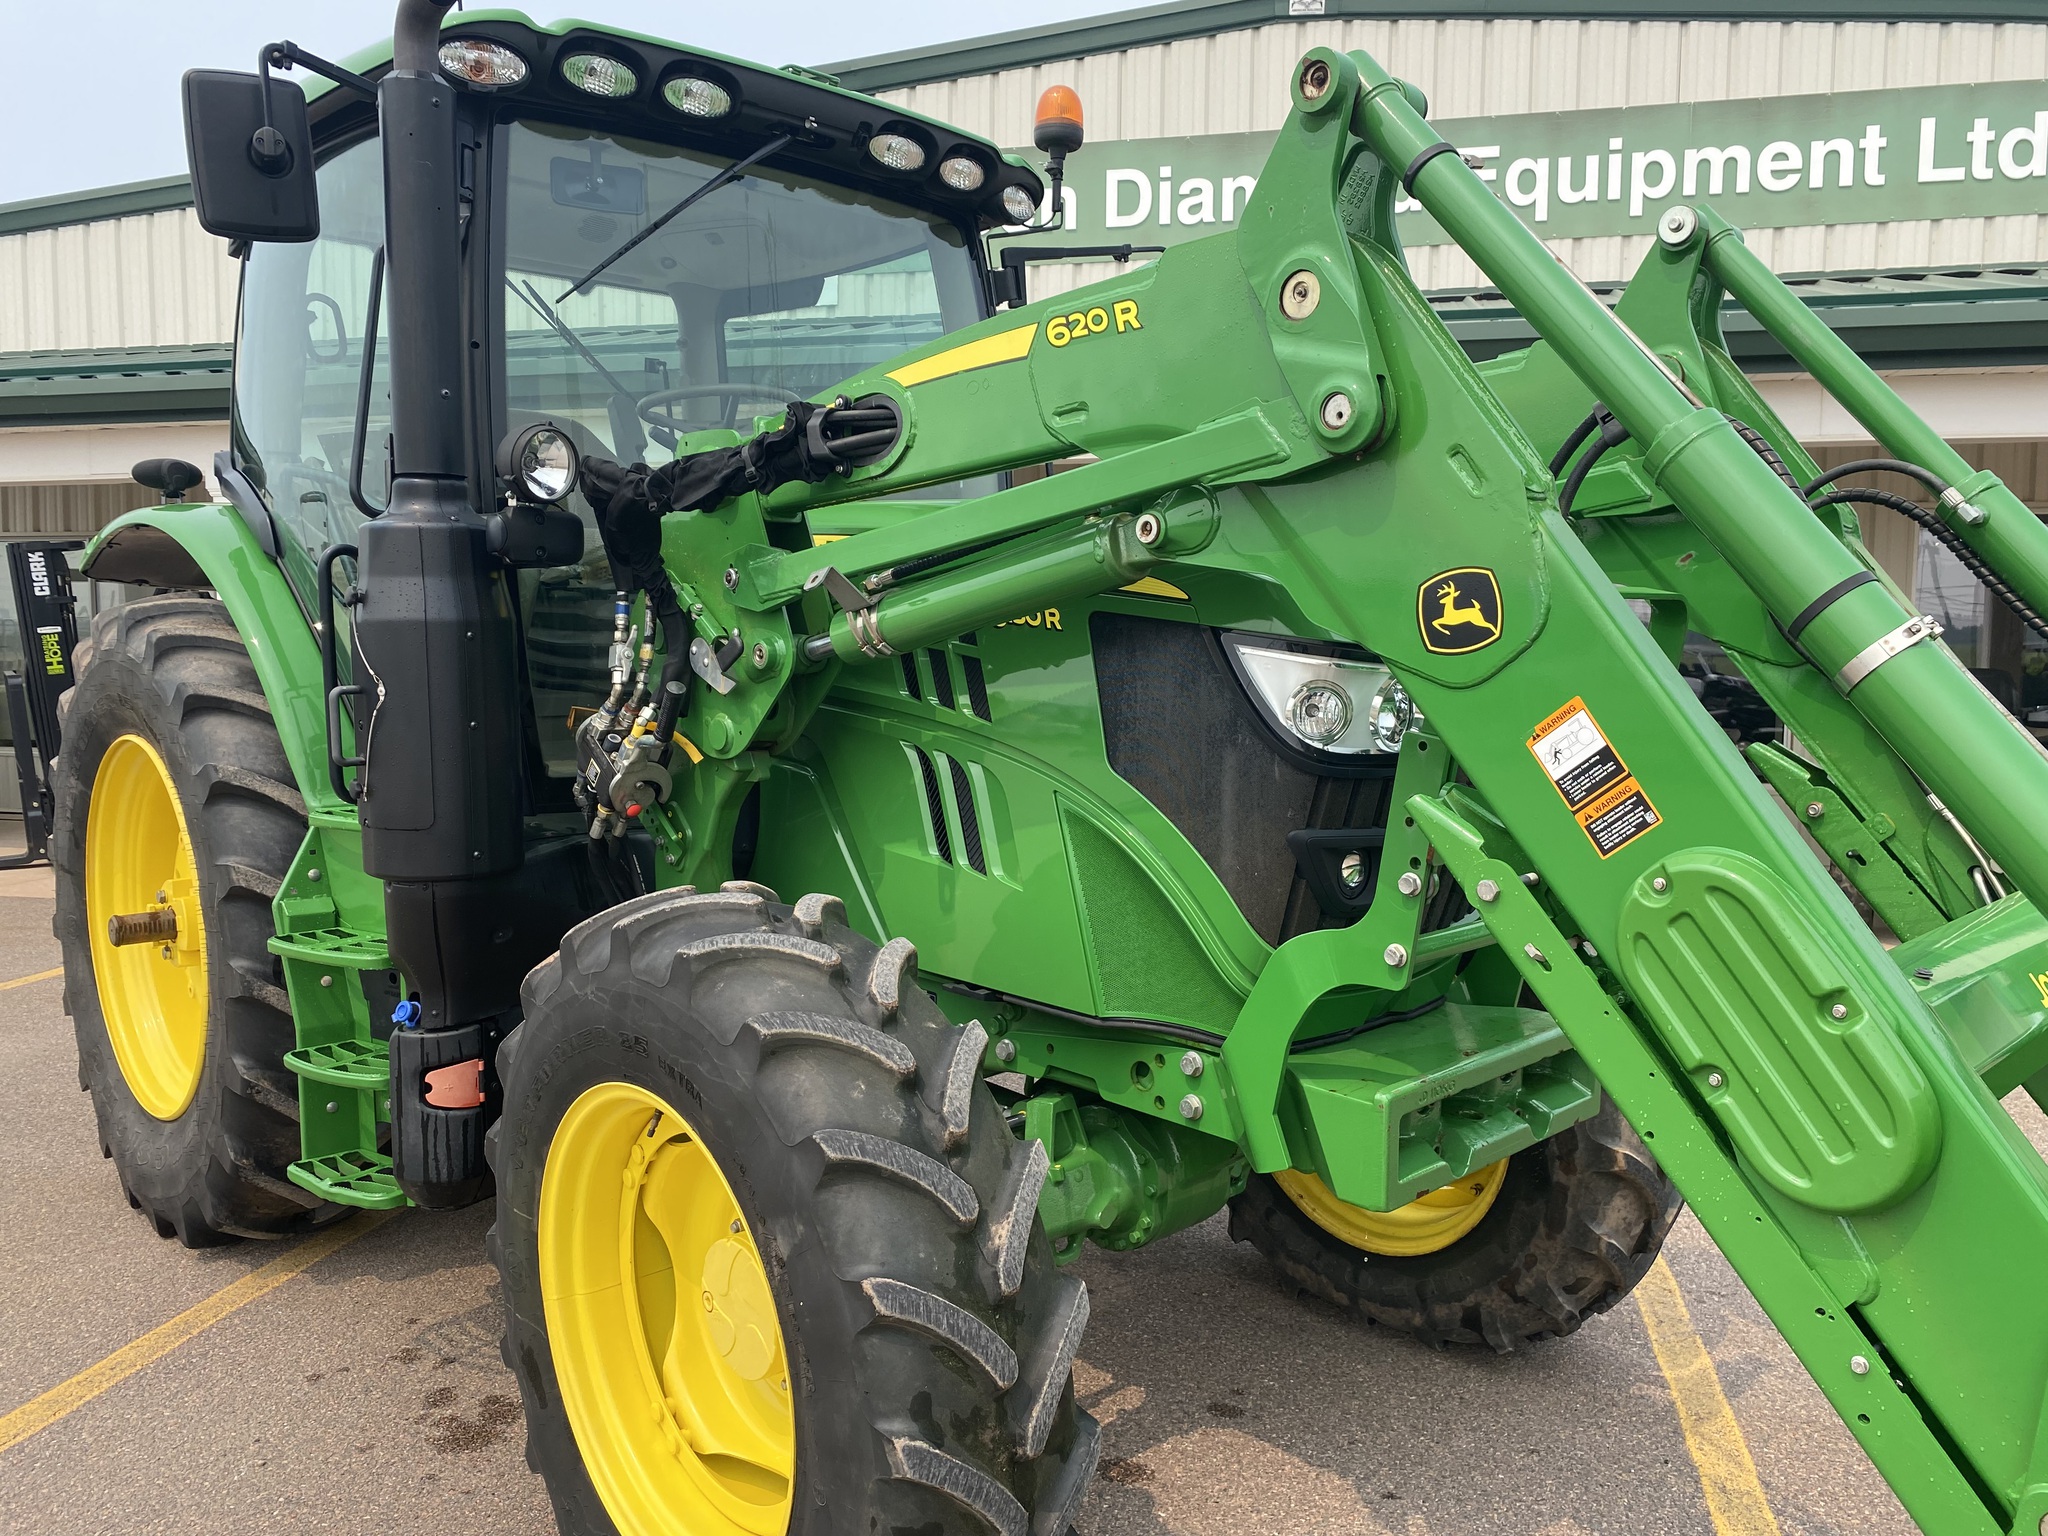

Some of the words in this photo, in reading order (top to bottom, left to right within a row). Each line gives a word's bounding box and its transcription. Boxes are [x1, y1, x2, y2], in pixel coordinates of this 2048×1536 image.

[1347, 165, 1361, 188] MADE
[1457, 125, 1888, 221] Equipment
[1918, 111, 2048, 183] Ltd
[1339, 193, 1347, 205] IN
[1046, 306, 1110, 348] 620
[1112, 299, 1144, 334] R
[28, 551, 51, 596] CLARK
[46, 634, 64, 670] HOPE
[1539, 704, 1577, 734] WARNING
[1593, 785, 1632, 815] WARNING
[657, 1055, 703, 1111] EXTRA
